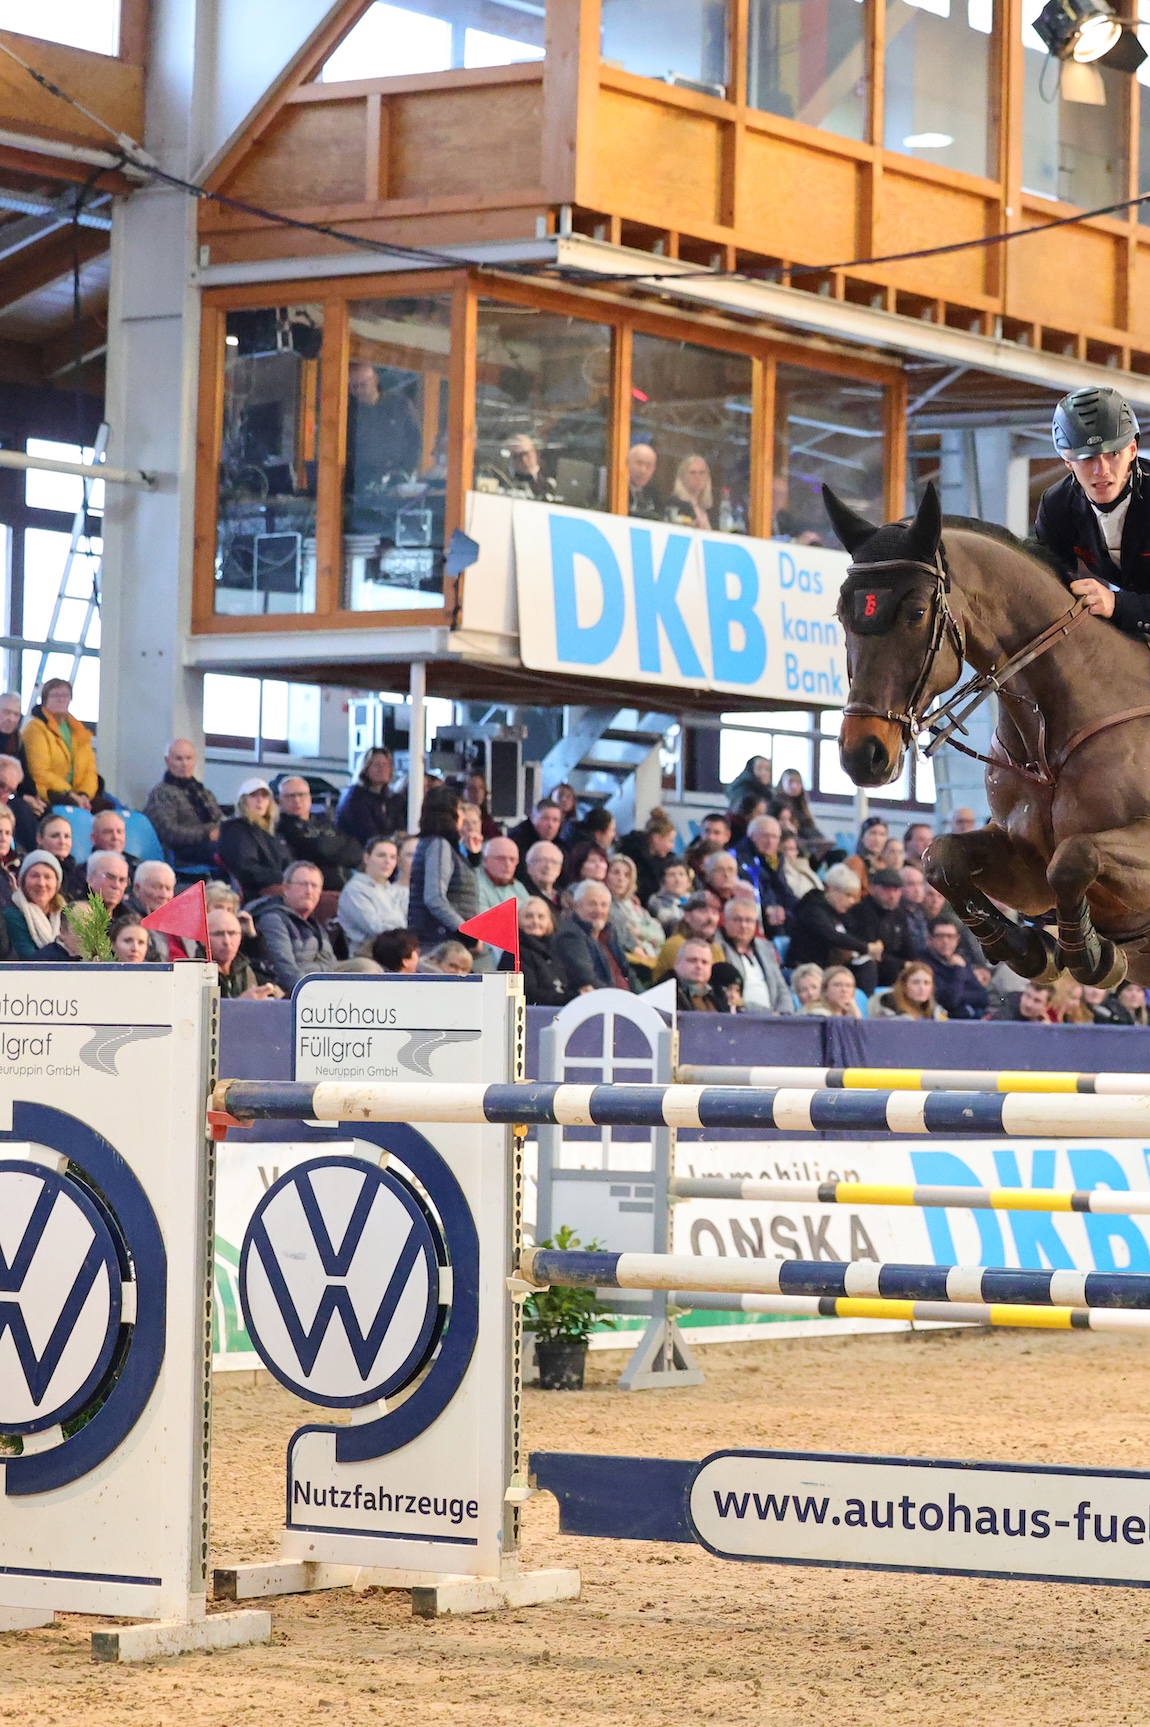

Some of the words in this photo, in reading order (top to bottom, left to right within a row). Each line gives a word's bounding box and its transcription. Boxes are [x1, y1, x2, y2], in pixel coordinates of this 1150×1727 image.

[778, 551, 823, 595] Das
[548, 514, 767, 685] DKB
[781, 601, 838, 647] kann
[785, 652, 844, 697] Bank
[0, 994, 79, 1017] tohaus
[301, 1003, 398, 1025] autohaus
[0, 1032, 53, 1061] lgraf
[300, 1036, 373, 1063] Füllgraf
[0, 1065, 43, 1077] euruppin
[45, 1064, 81, 1077] GmbH
[315, 1066, 365, 1079] Neuruppin
[367, 1066, 399, 1077] GmbH
[293, 1480, 479, 1524] Nutzfahrzeuge
